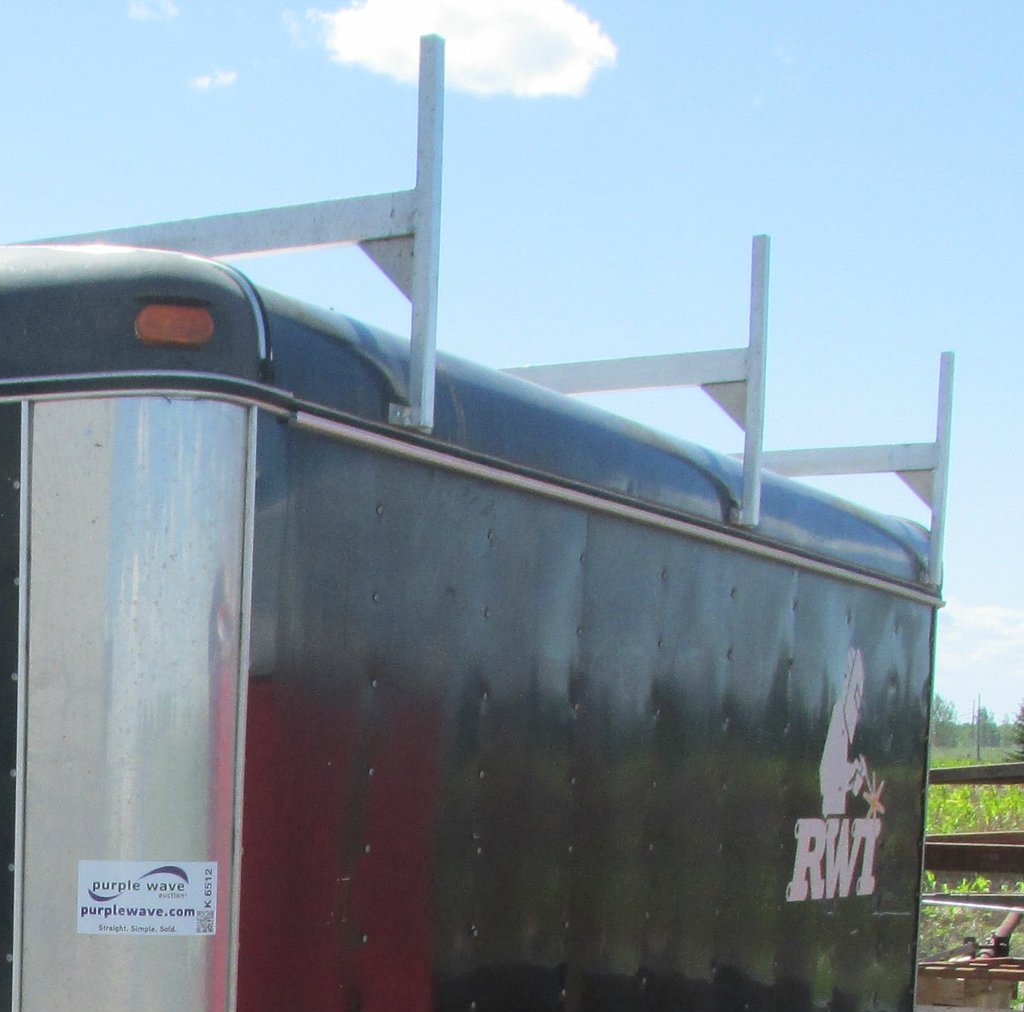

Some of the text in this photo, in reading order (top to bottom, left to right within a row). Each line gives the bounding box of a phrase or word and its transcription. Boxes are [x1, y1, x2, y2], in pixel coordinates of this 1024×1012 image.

[786, 818, 881, 902] RWI
[92, 880, 185, 892] purple wave
[204, 868, 213, 909] K 6512
[80, 904, 195, 918] purplewave.com
[98, 924, 129, 933] Straight.
[131, 925, 158, 933] Simple.
